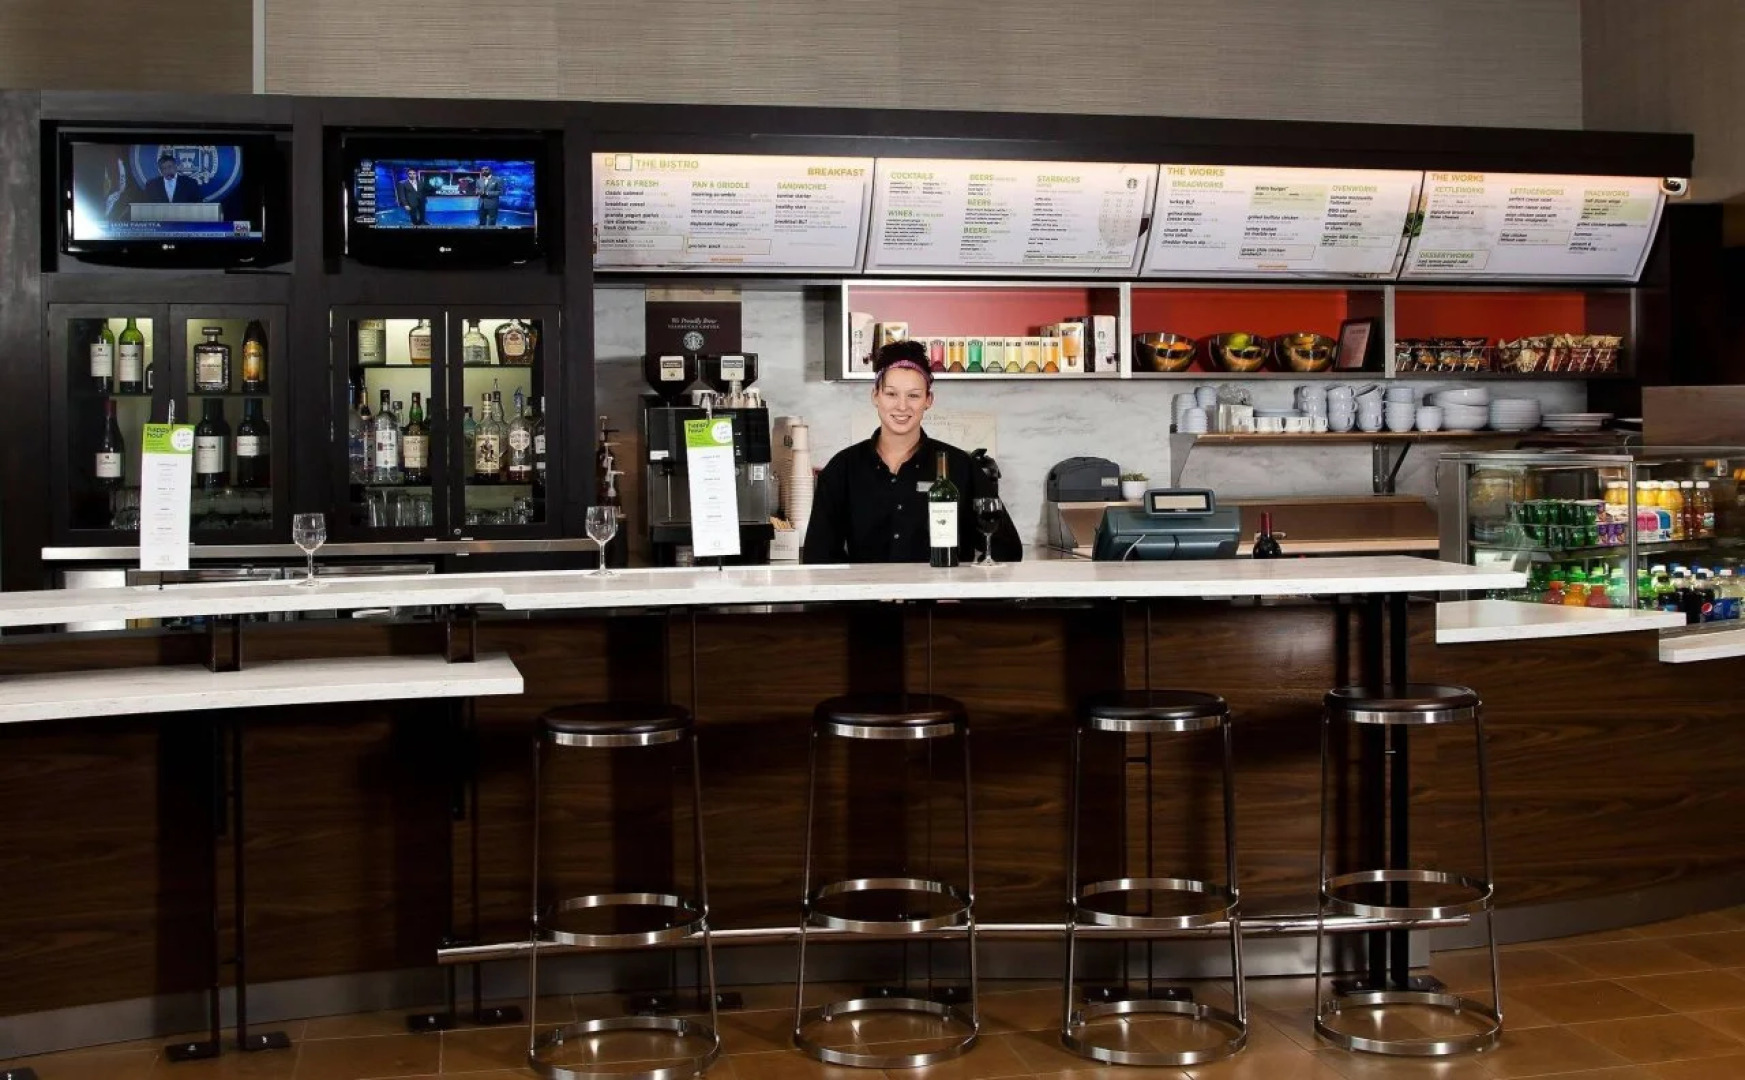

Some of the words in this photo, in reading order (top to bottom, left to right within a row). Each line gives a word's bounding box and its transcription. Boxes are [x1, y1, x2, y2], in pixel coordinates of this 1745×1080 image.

[636, 159, 657, 168] THE
[660, 159, 699, 168] BISTRO
[807, 168, 864, 176] BREAKFAST
[1167, 167, 1186, 176] THE
[1190, 168, 1224, 176] WORKS
[606, 180, 625, 188] FAST
[634, 180, 659, 188] FRESH
[776, 182, 827, 190] SANDWICHES
[1510, 188, 1564, 196] LETTUCEWORKS
